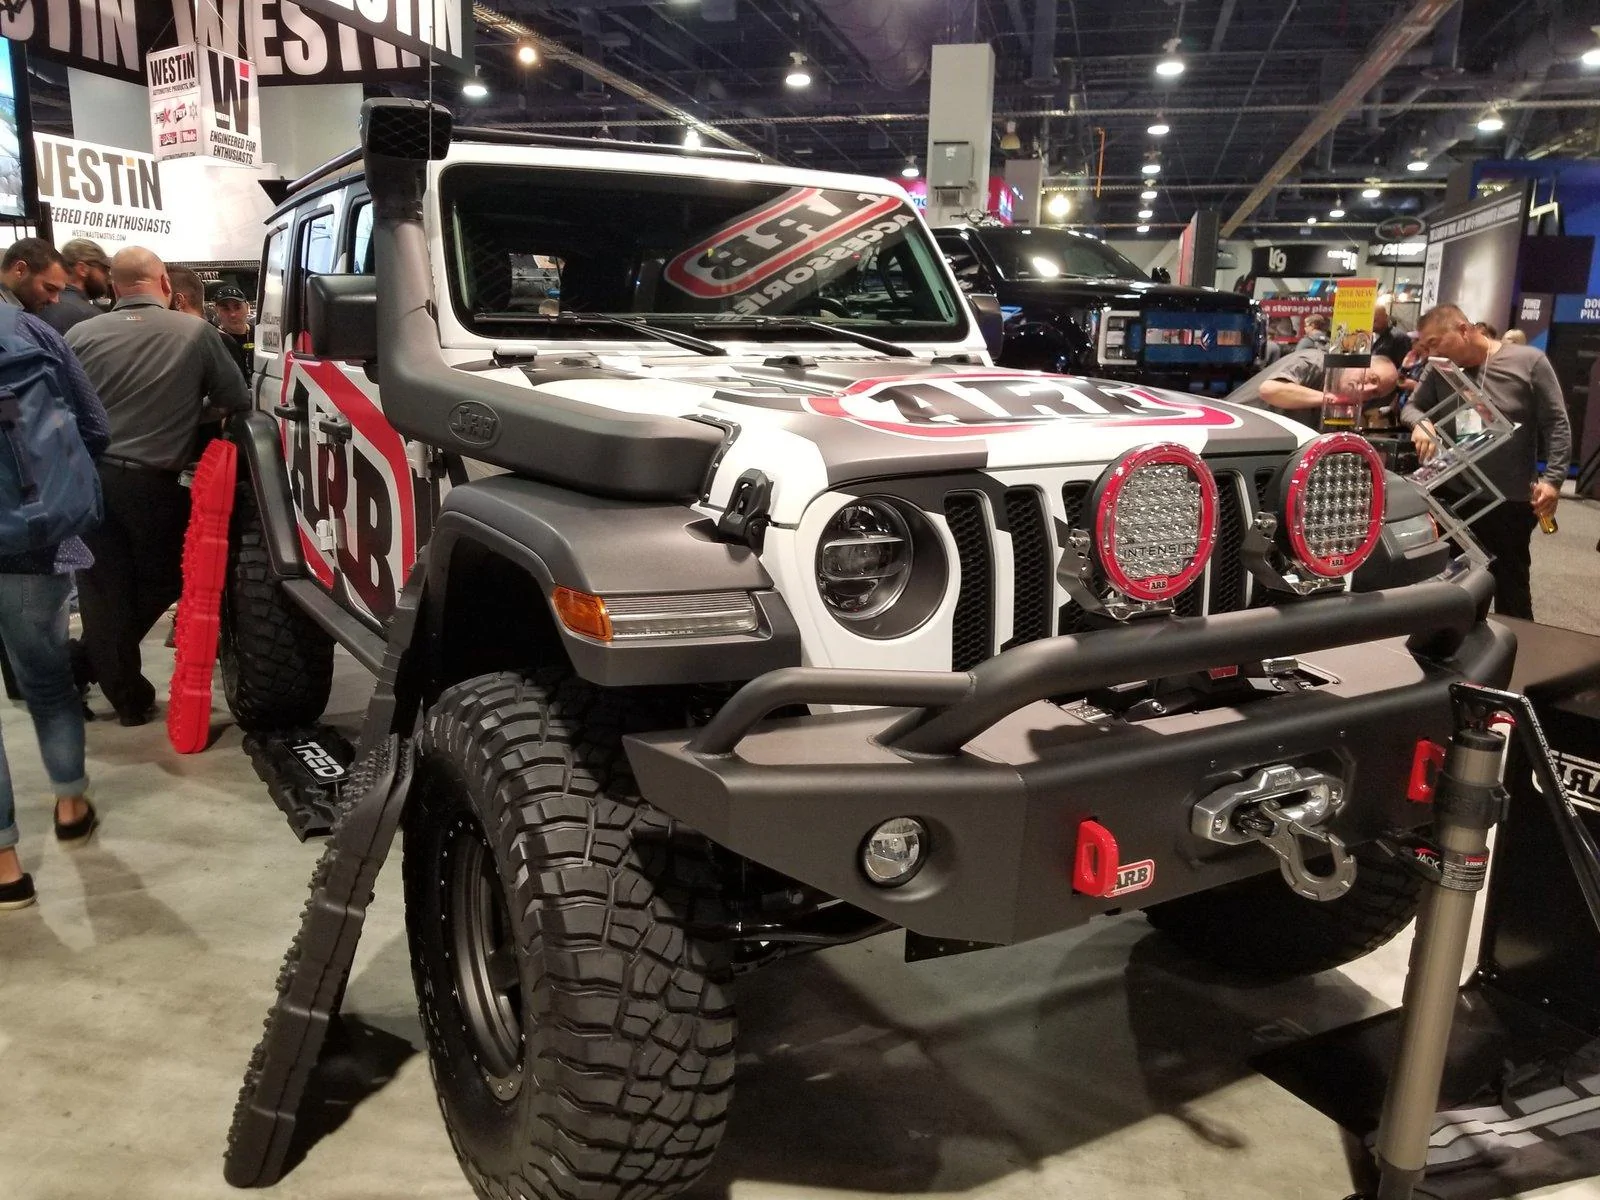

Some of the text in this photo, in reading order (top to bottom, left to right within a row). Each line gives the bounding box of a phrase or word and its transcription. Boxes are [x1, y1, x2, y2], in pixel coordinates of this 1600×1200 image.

[210, 130, 257, 153] ENGINEERED FOR
[213, 145, 254, 165] ENTHUSIASTS
[83, 211, 104, 227] FOR
[105, 213, 172, 235] ENTHUSIASTS
[1355, 288, 1373, 297] NEW
[1272, 304, 1310, 314] storage
[868, 379, 1148, 425] ARB
[1151, 581, 1167, 590] ARB
[292, 741, 346, 778] TRED
[1416, 852, 1441, 869] JACK
